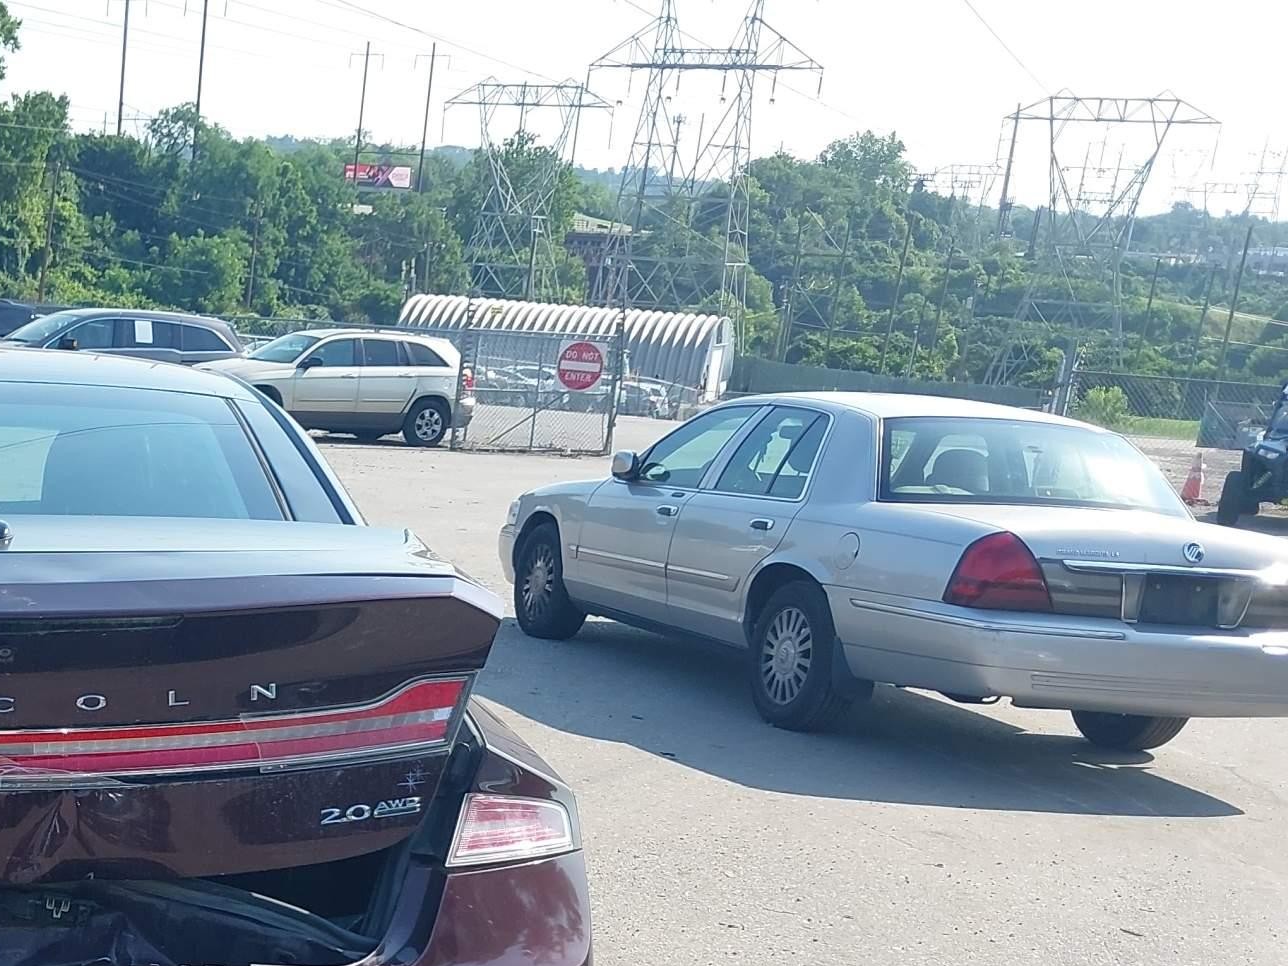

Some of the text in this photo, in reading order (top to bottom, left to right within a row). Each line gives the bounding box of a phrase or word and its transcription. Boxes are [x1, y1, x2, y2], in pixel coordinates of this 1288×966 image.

[565, 350, 600, 361] DO NOT
[564, 371, 592, 382] ENTER
[374, 797, 421, 815] AWD
